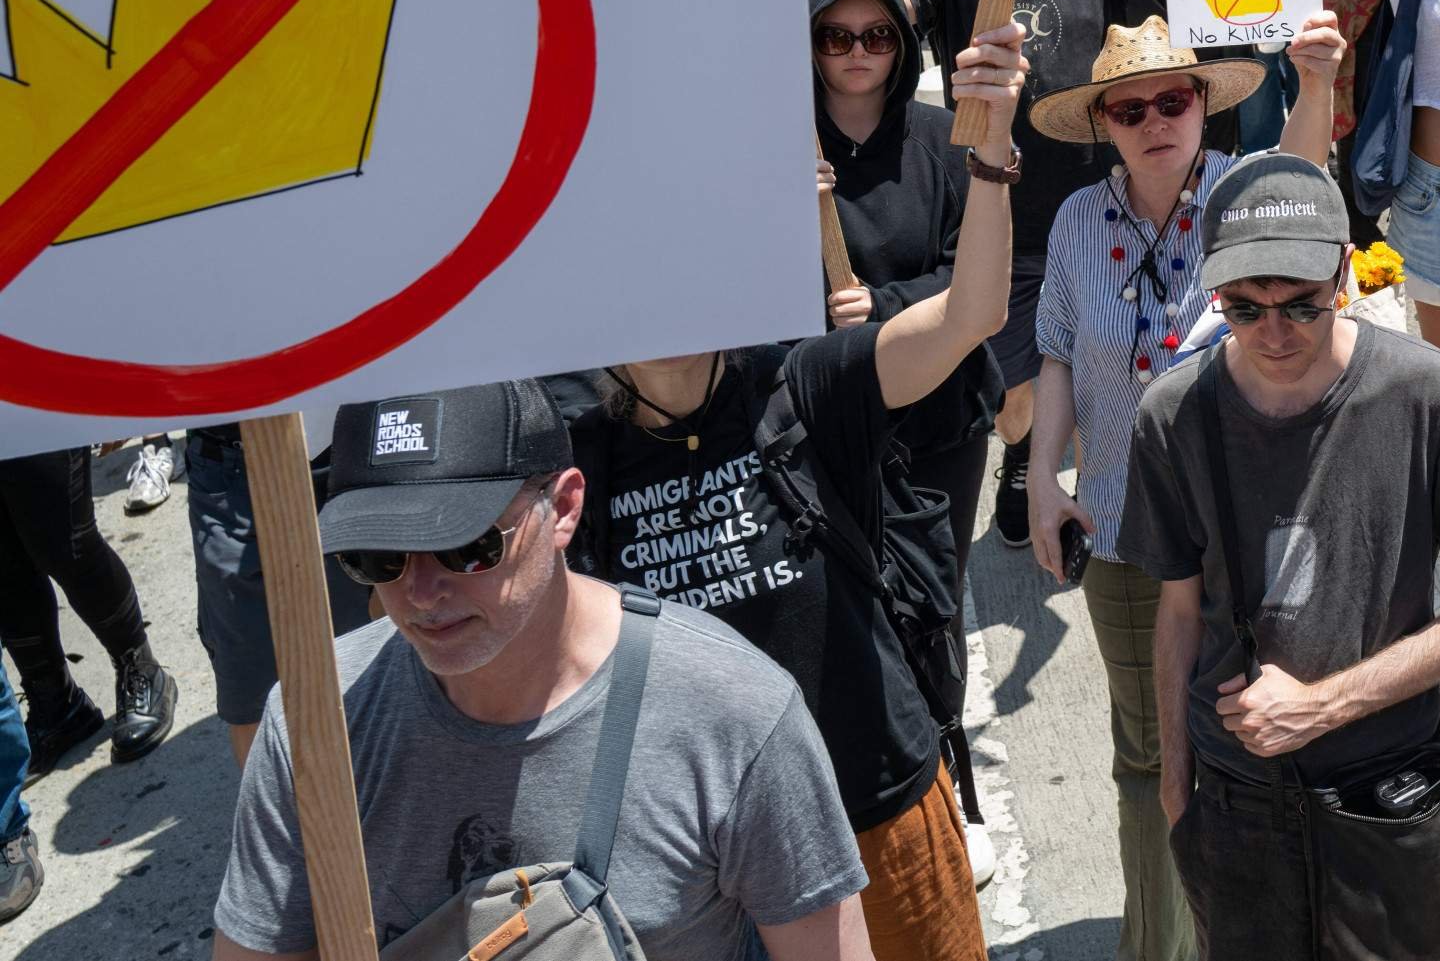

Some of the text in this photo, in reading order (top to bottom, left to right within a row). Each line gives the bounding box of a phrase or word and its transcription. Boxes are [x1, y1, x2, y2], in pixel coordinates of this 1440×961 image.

[1227, 22, 1295, 42] KINGS
[1255, 199, 1317, 218] ambient
[378, 410, 409, 427] NEW
[377, 423, 422, 441] ROADS
[375, 436, 429, 456] SCHOOL
[609, 450, 763, 520] IMMIGRANTS
[633, 486, 745, 539] ARE NOT
[619, 511, 768, 570] CRIMINALS,
[643, 544, 751, 593] BUT THE
[763, 559, 803, 591] IS.
